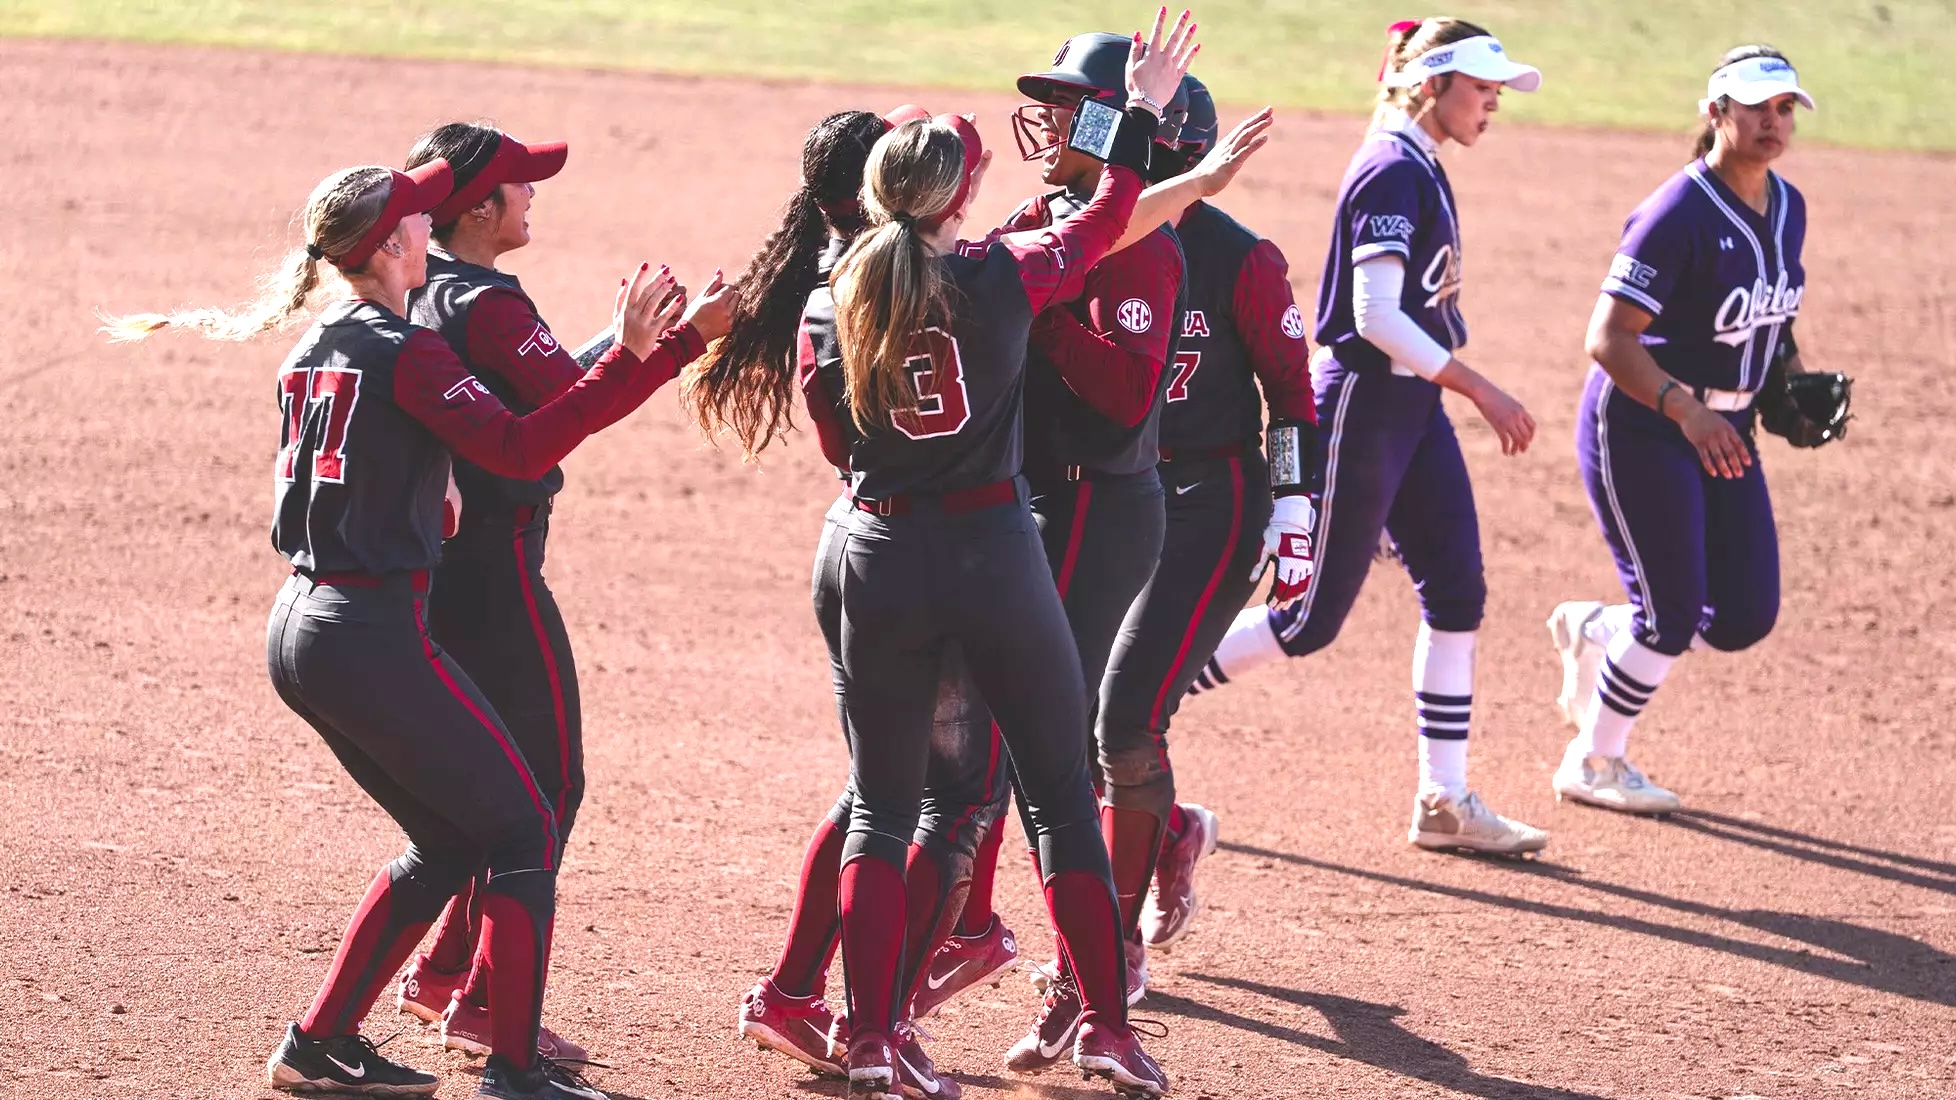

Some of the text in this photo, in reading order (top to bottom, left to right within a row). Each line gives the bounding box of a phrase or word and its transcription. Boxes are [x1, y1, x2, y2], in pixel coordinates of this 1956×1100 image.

[1610, 253, 1658, 289] AC
[1120, 301, 1150, 331] SEC
[1283, 307, 1304, 337] SEC
[890, 326, 971, 440] 3
[1166, 351, 1201, 403] 7
[274, 366, 363, 484] 77
